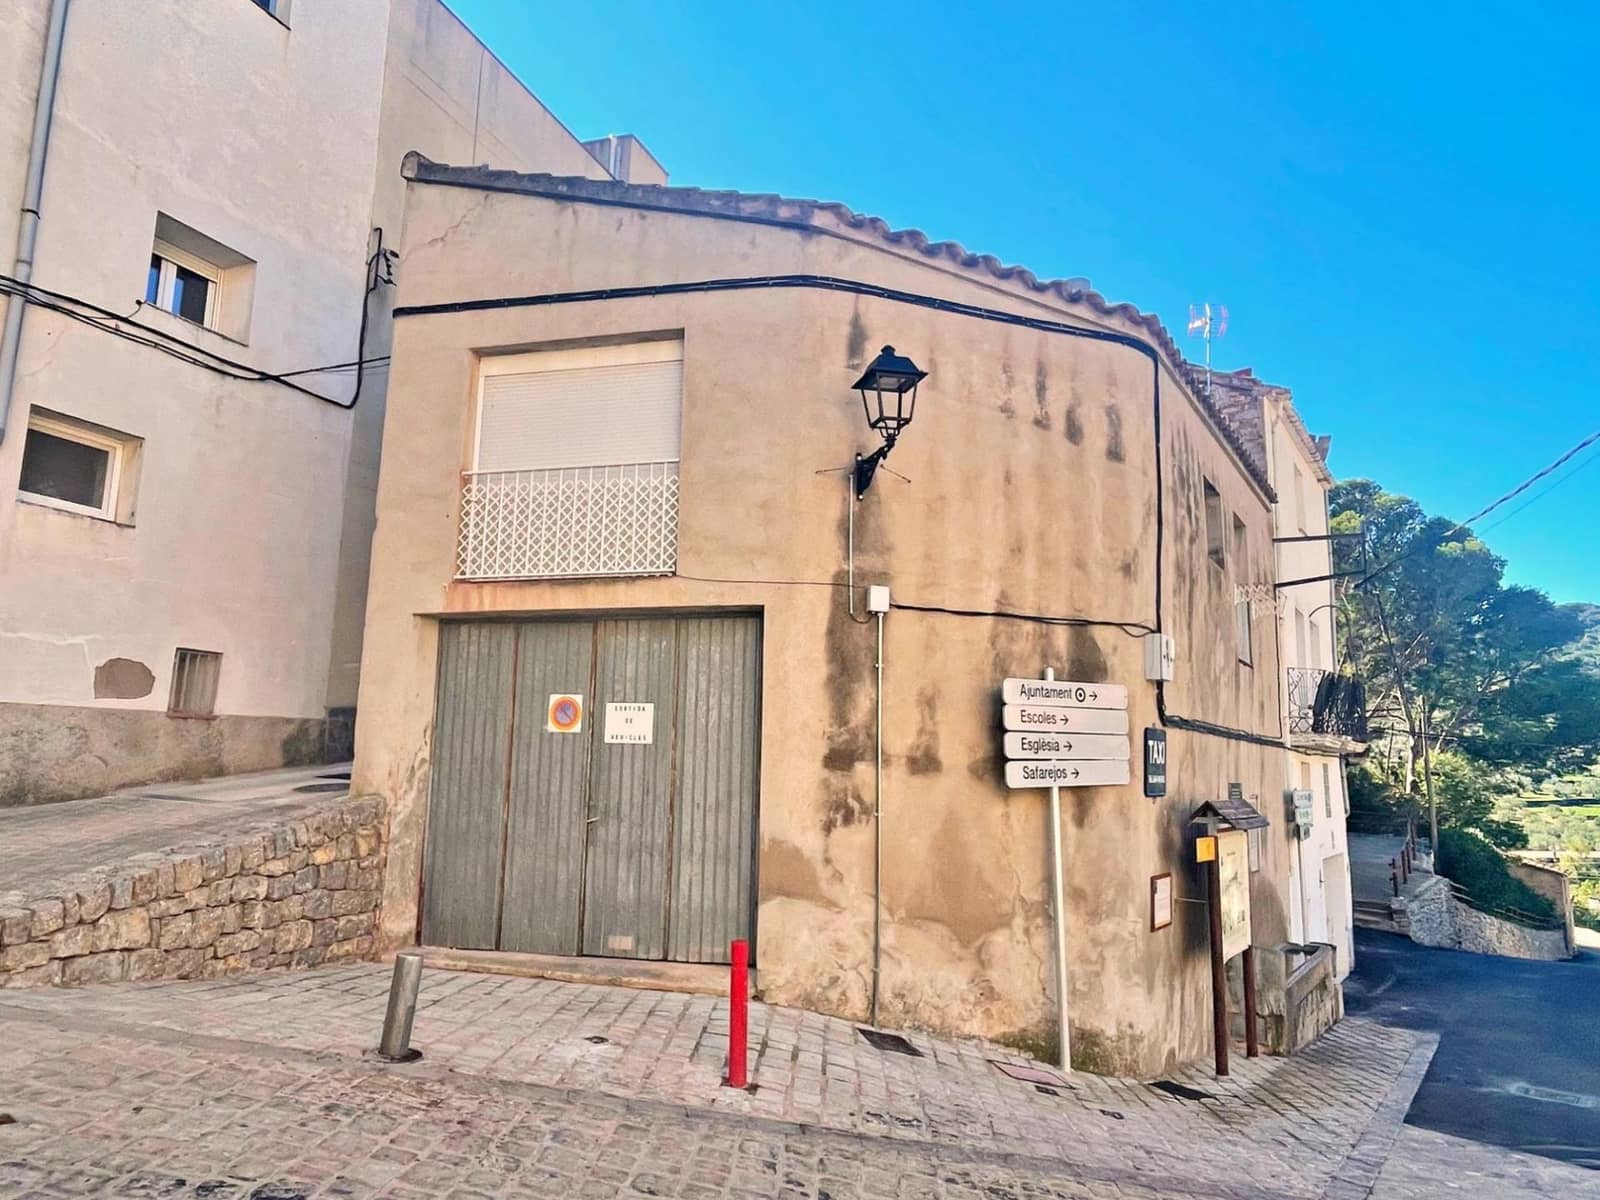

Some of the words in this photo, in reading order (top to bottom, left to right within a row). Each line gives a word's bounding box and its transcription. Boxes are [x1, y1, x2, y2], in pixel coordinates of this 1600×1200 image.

[1020, 684, 1072, 700] Ajuntament
[1020, 709, 1057, 725] Escoles
[1148, 740, 1165, 764] TAXI
[1022, 765, 1068, 782] Safarejos
